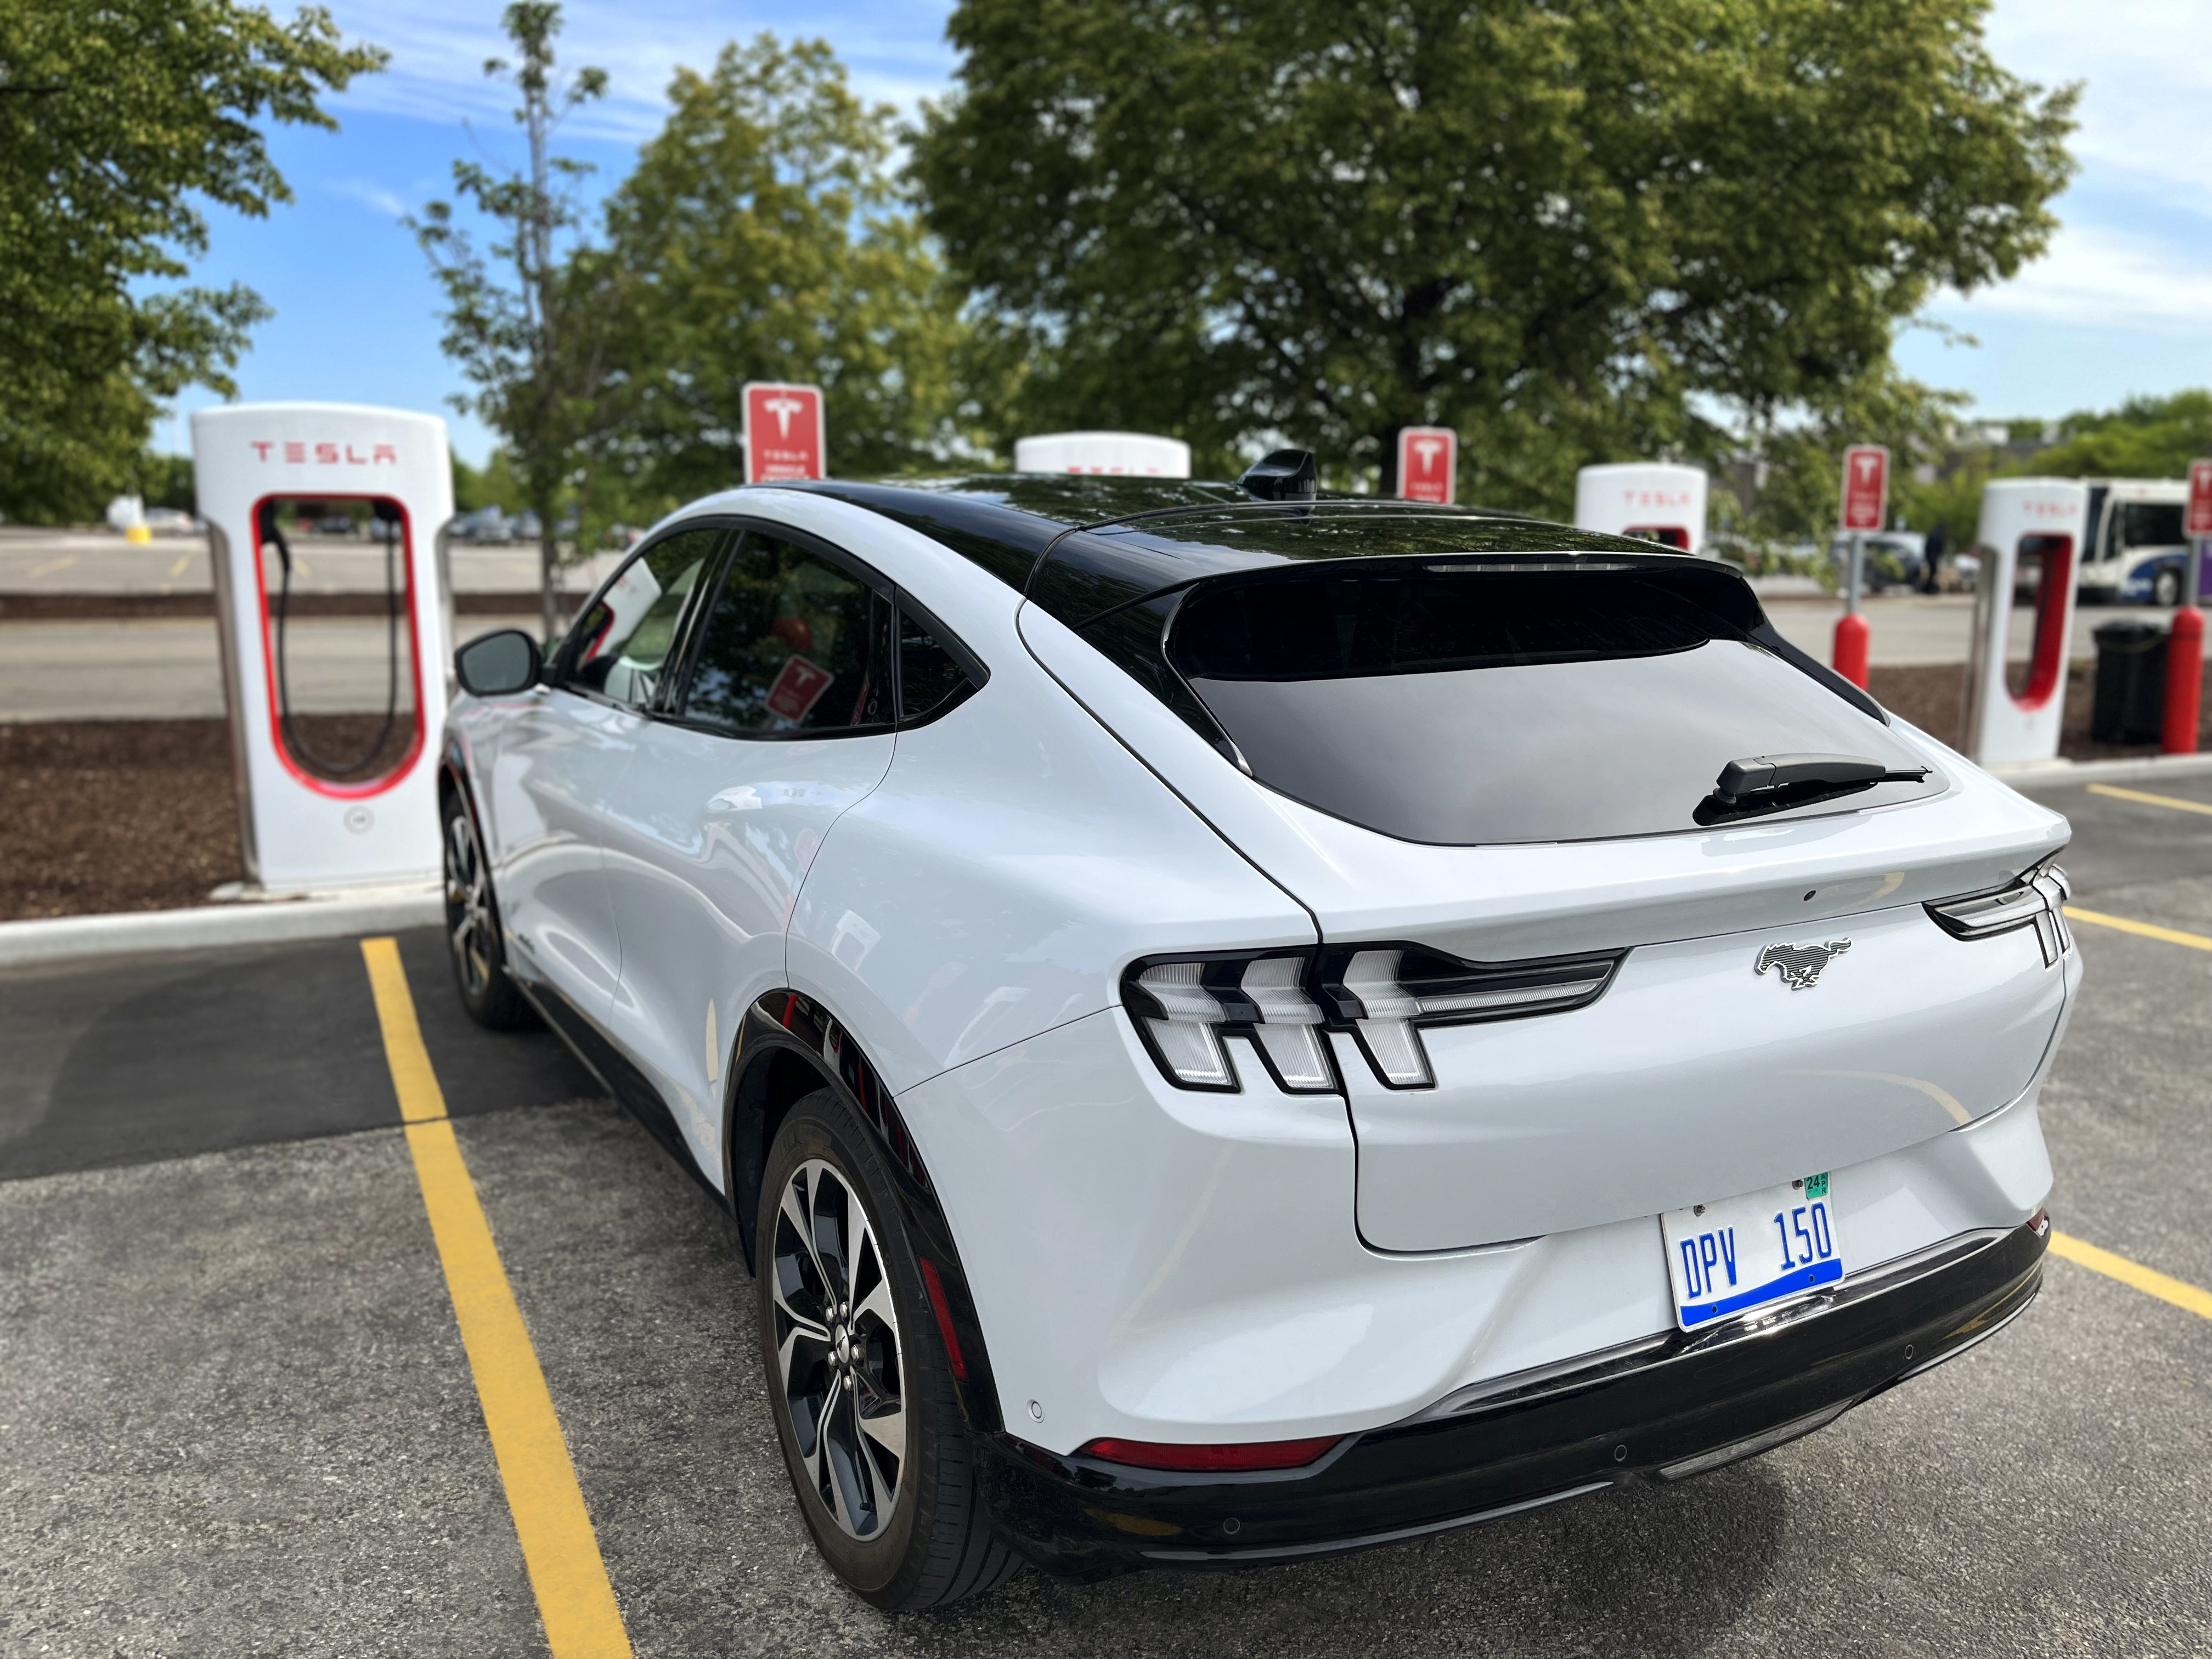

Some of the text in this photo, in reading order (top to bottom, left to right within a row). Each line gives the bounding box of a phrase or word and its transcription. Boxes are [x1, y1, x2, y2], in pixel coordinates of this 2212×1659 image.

[250, 441, 396, 465] TESLA
[1807, 1175, 1820, 1190] 24
[1680, 1202, 1832, 1299] DPV 150
